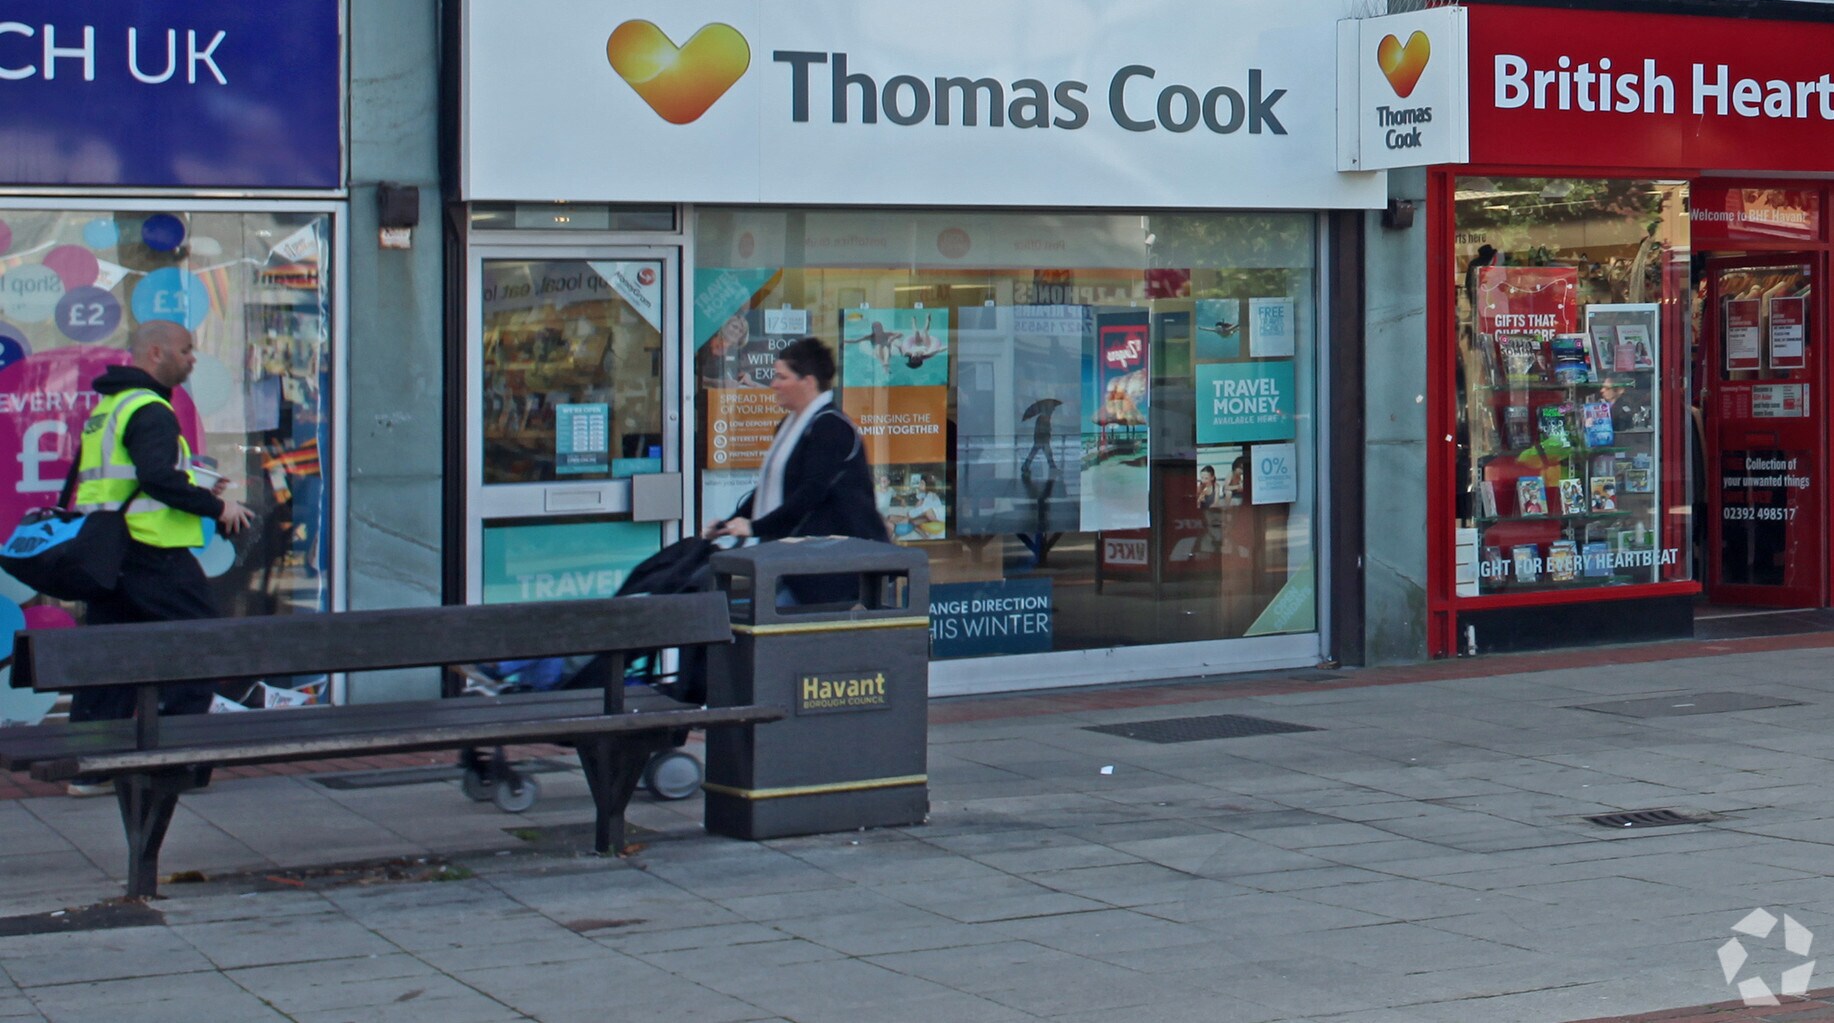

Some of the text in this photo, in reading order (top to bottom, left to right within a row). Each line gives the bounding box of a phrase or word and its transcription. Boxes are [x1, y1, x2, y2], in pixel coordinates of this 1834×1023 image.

[0, 21, 228, 85] CH UK
[773, 50, 1288, 136] Thomas Cook
[1493, 54, 1834, 119] British Heart
[1376, 105, 1432, 128] Thomas
[1385, 126, 1422, 149] Cook
[1691, 208, 1806, 223] Welcome to BHF Havant
[153, 290, 188, 314] £1
[69, 303, 105, 326] £2
[1258, 306, 1285, 318] FREE
[1495, 313, 1556, 327] GIFTS THAT
[767, 316, 788, 330] 175
[1212, 378, 1279, 397] TRAVEL
[0, 390, 102, 413] EVERYT
[720, 393, 778, 404] SPREAD THE
[1213, 396, 1280, 415] MONEY
[720, 406, 735, 415] OF
[737, 405, 763, 415] YOUR
[860, 413, 931, 424] BRINGING THE
[1213, 415, 1278, 425] AVAILABLE HERE
[857, 424, 939, 435] AMILY TOGETHER
[1261, 457, 1288, 475] 0%
[1745, 457, 1786, 470] Collection
[1787, 458, 1797, 470] of
[1723, 475, 1810, 489] your unwanted things
[1723, 507, 1796, 521] 02392 498517
[1481, 548, 1679, 578] GHT FOR EVERY HEARTBEAT
[929, 596, 1048, 616] ANGE DIRECTION
[929, 613, 1049, 640] HIS WINTER
[803, 672, 885, 700] Havant
[803, 695, 885, 710] BOROUGH COUNCIL
